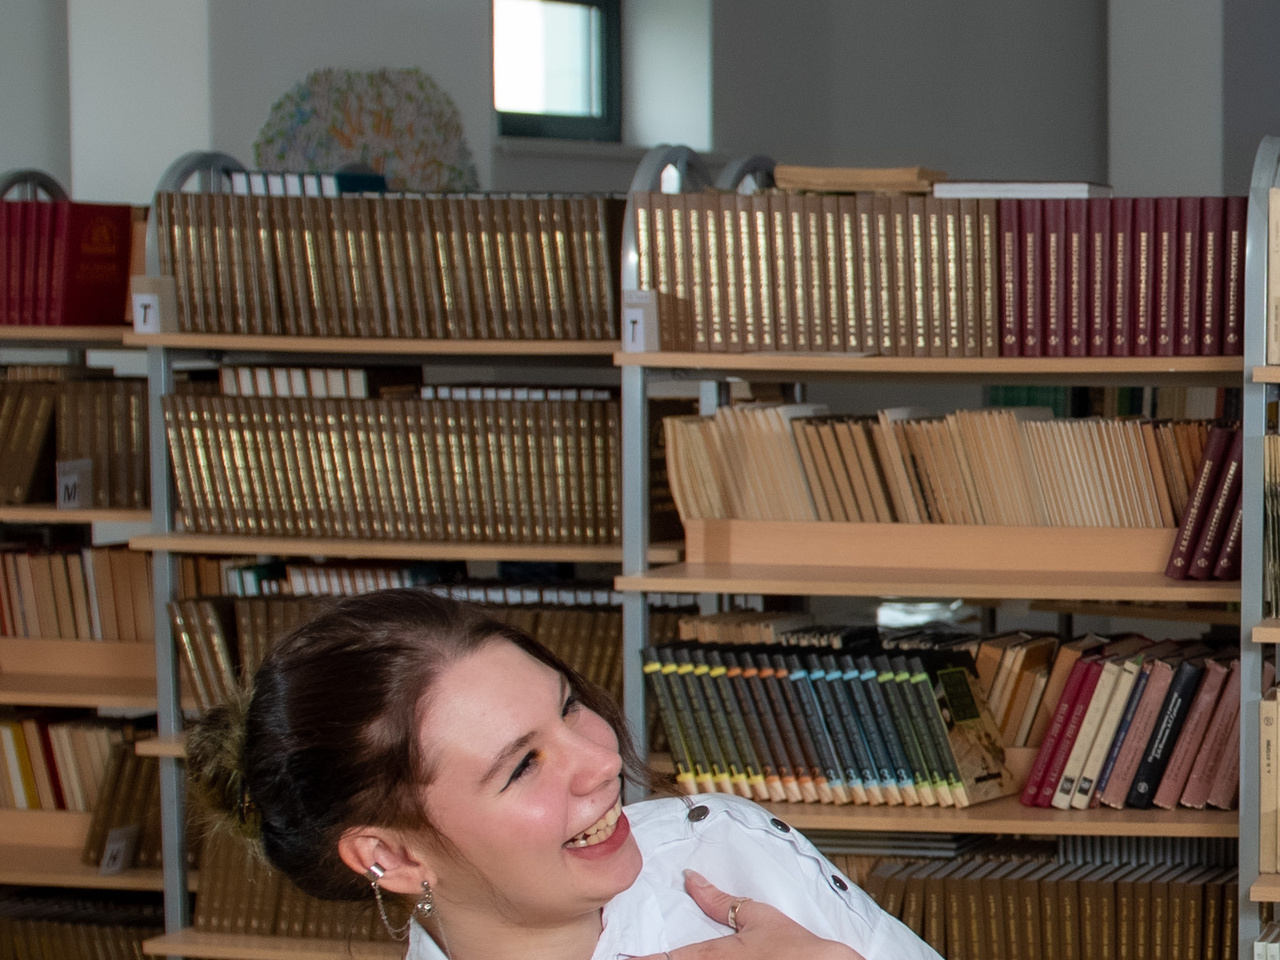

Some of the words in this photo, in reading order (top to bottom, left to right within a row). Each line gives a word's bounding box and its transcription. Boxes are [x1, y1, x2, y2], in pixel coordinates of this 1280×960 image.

[140, 303, 151, 326] Т
[629, 319, 638, 343] Т
[63, 482, 77, 503] М
